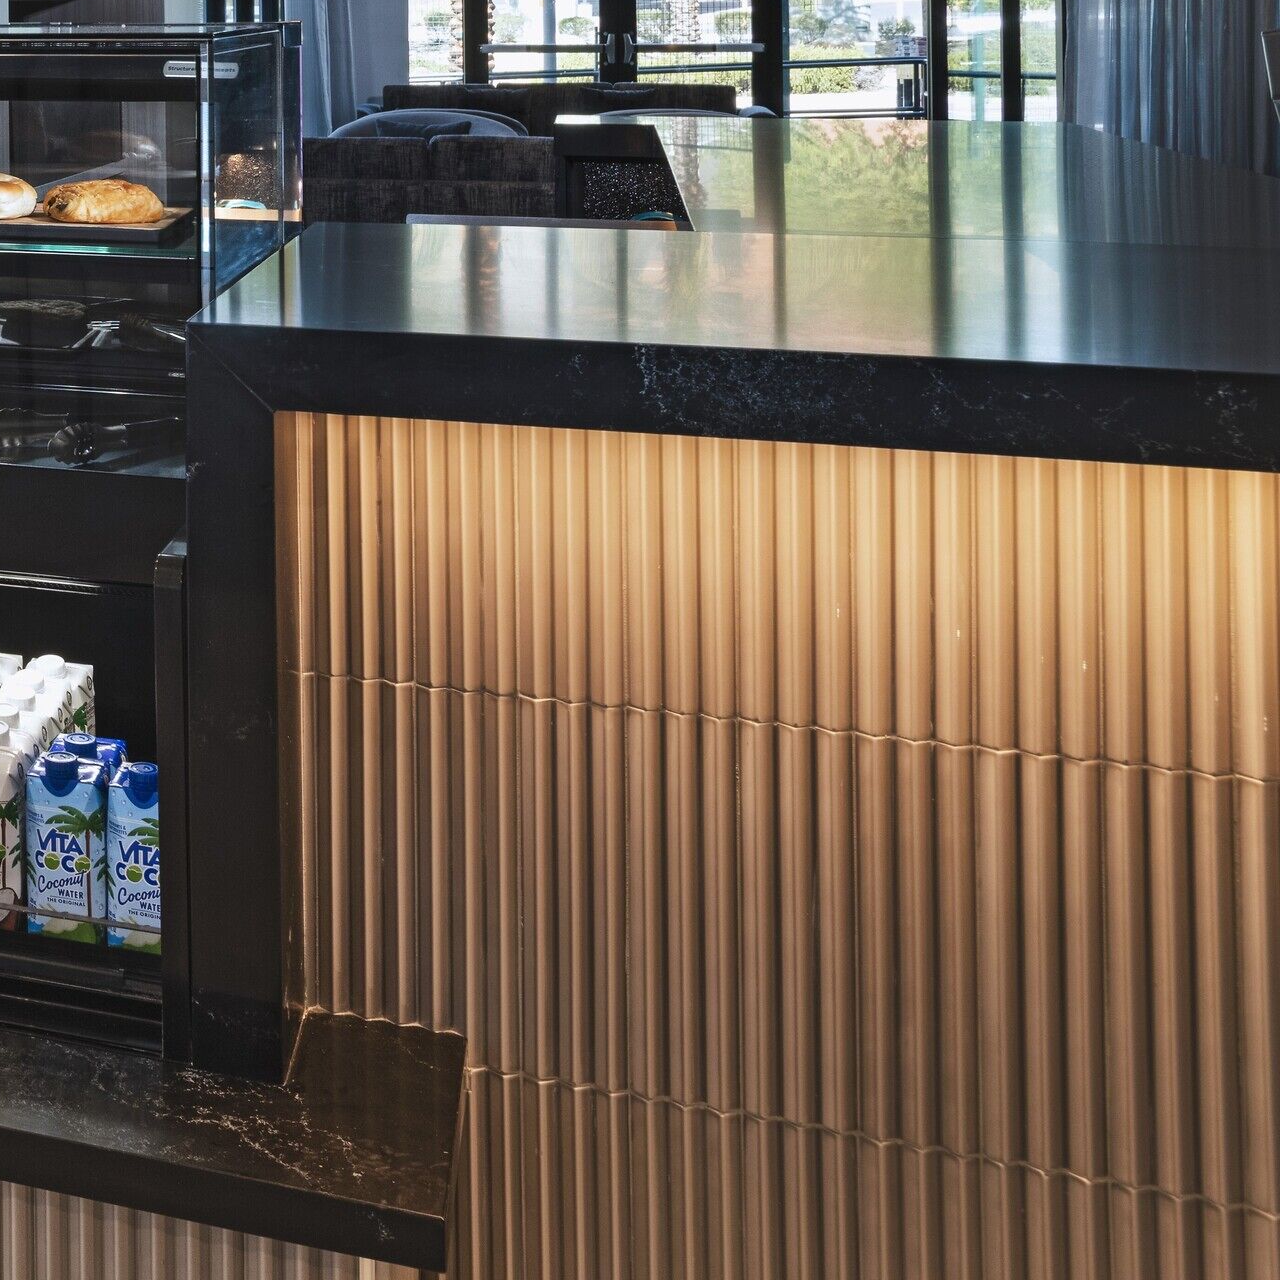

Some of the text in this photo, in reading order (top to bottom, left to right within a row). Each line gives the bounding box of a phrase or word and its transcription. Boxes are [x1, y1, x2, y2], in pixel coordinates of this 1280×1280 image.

[37, 828, 84, 856] VITA
[115, 862, 160, 886] COC
[37, 869, 86, 893] Coconut
[57, 888, 84, 899] WATER
[58, 898, 86, 907] ORIGINAL
[140, 901, 160, 913] WATE
[139, 911, 160, 920] ORIGIN
